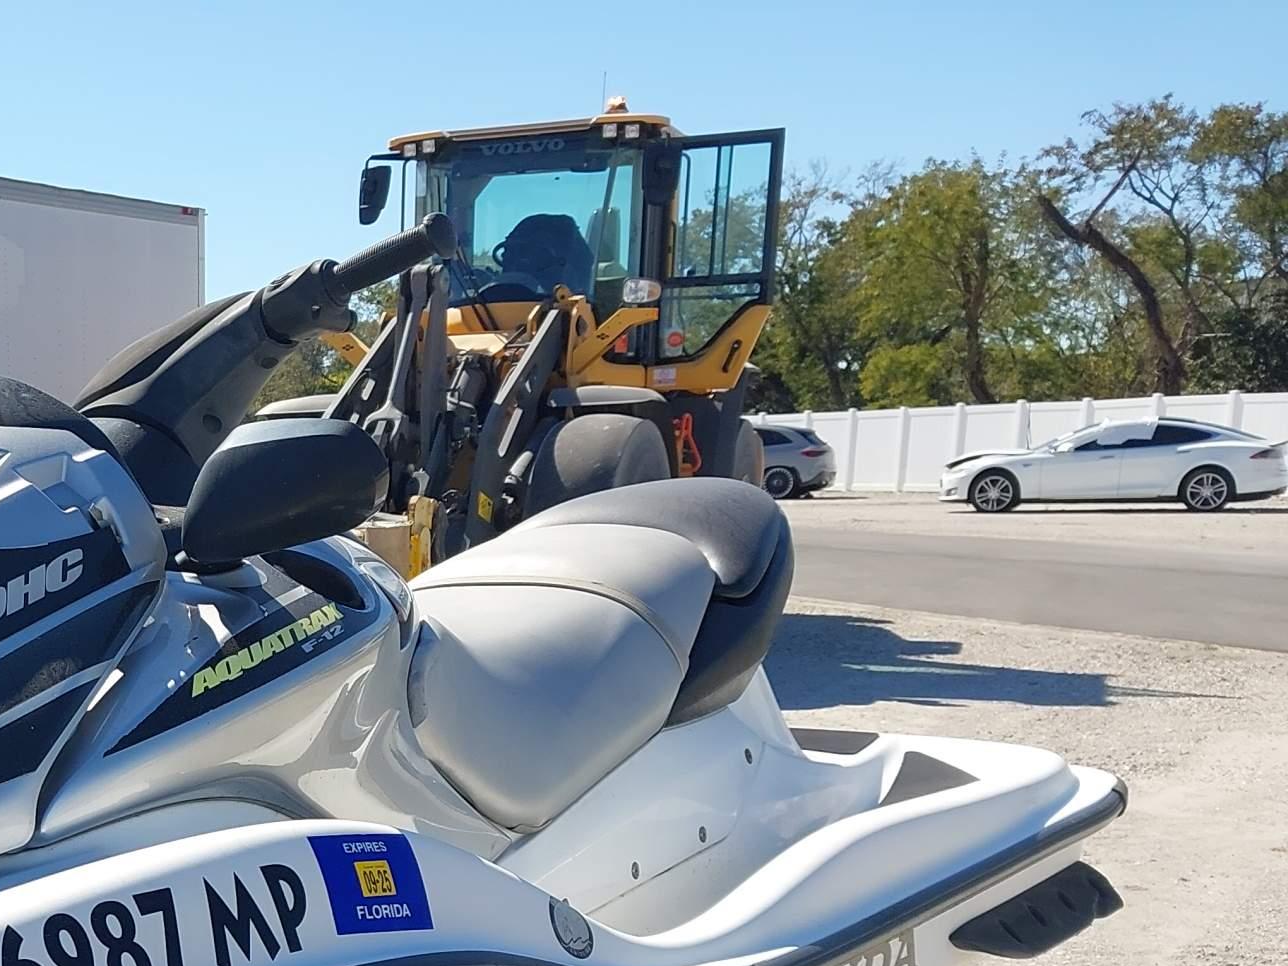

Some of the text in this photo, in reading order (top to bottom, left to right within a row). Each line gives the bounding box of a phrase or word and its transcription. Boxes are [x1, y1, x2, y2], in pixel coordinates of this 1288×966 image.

[479, 138, 566, 156] VOLVO
[192, 601, 345, 698] AQUATRAX
[300, 624, 345, 654] F-12
[342, 841, 388, 854] EXPIRES
[363, 868, 393, 895] 09-25
[356, 903, 412, 920] FLORIDA
